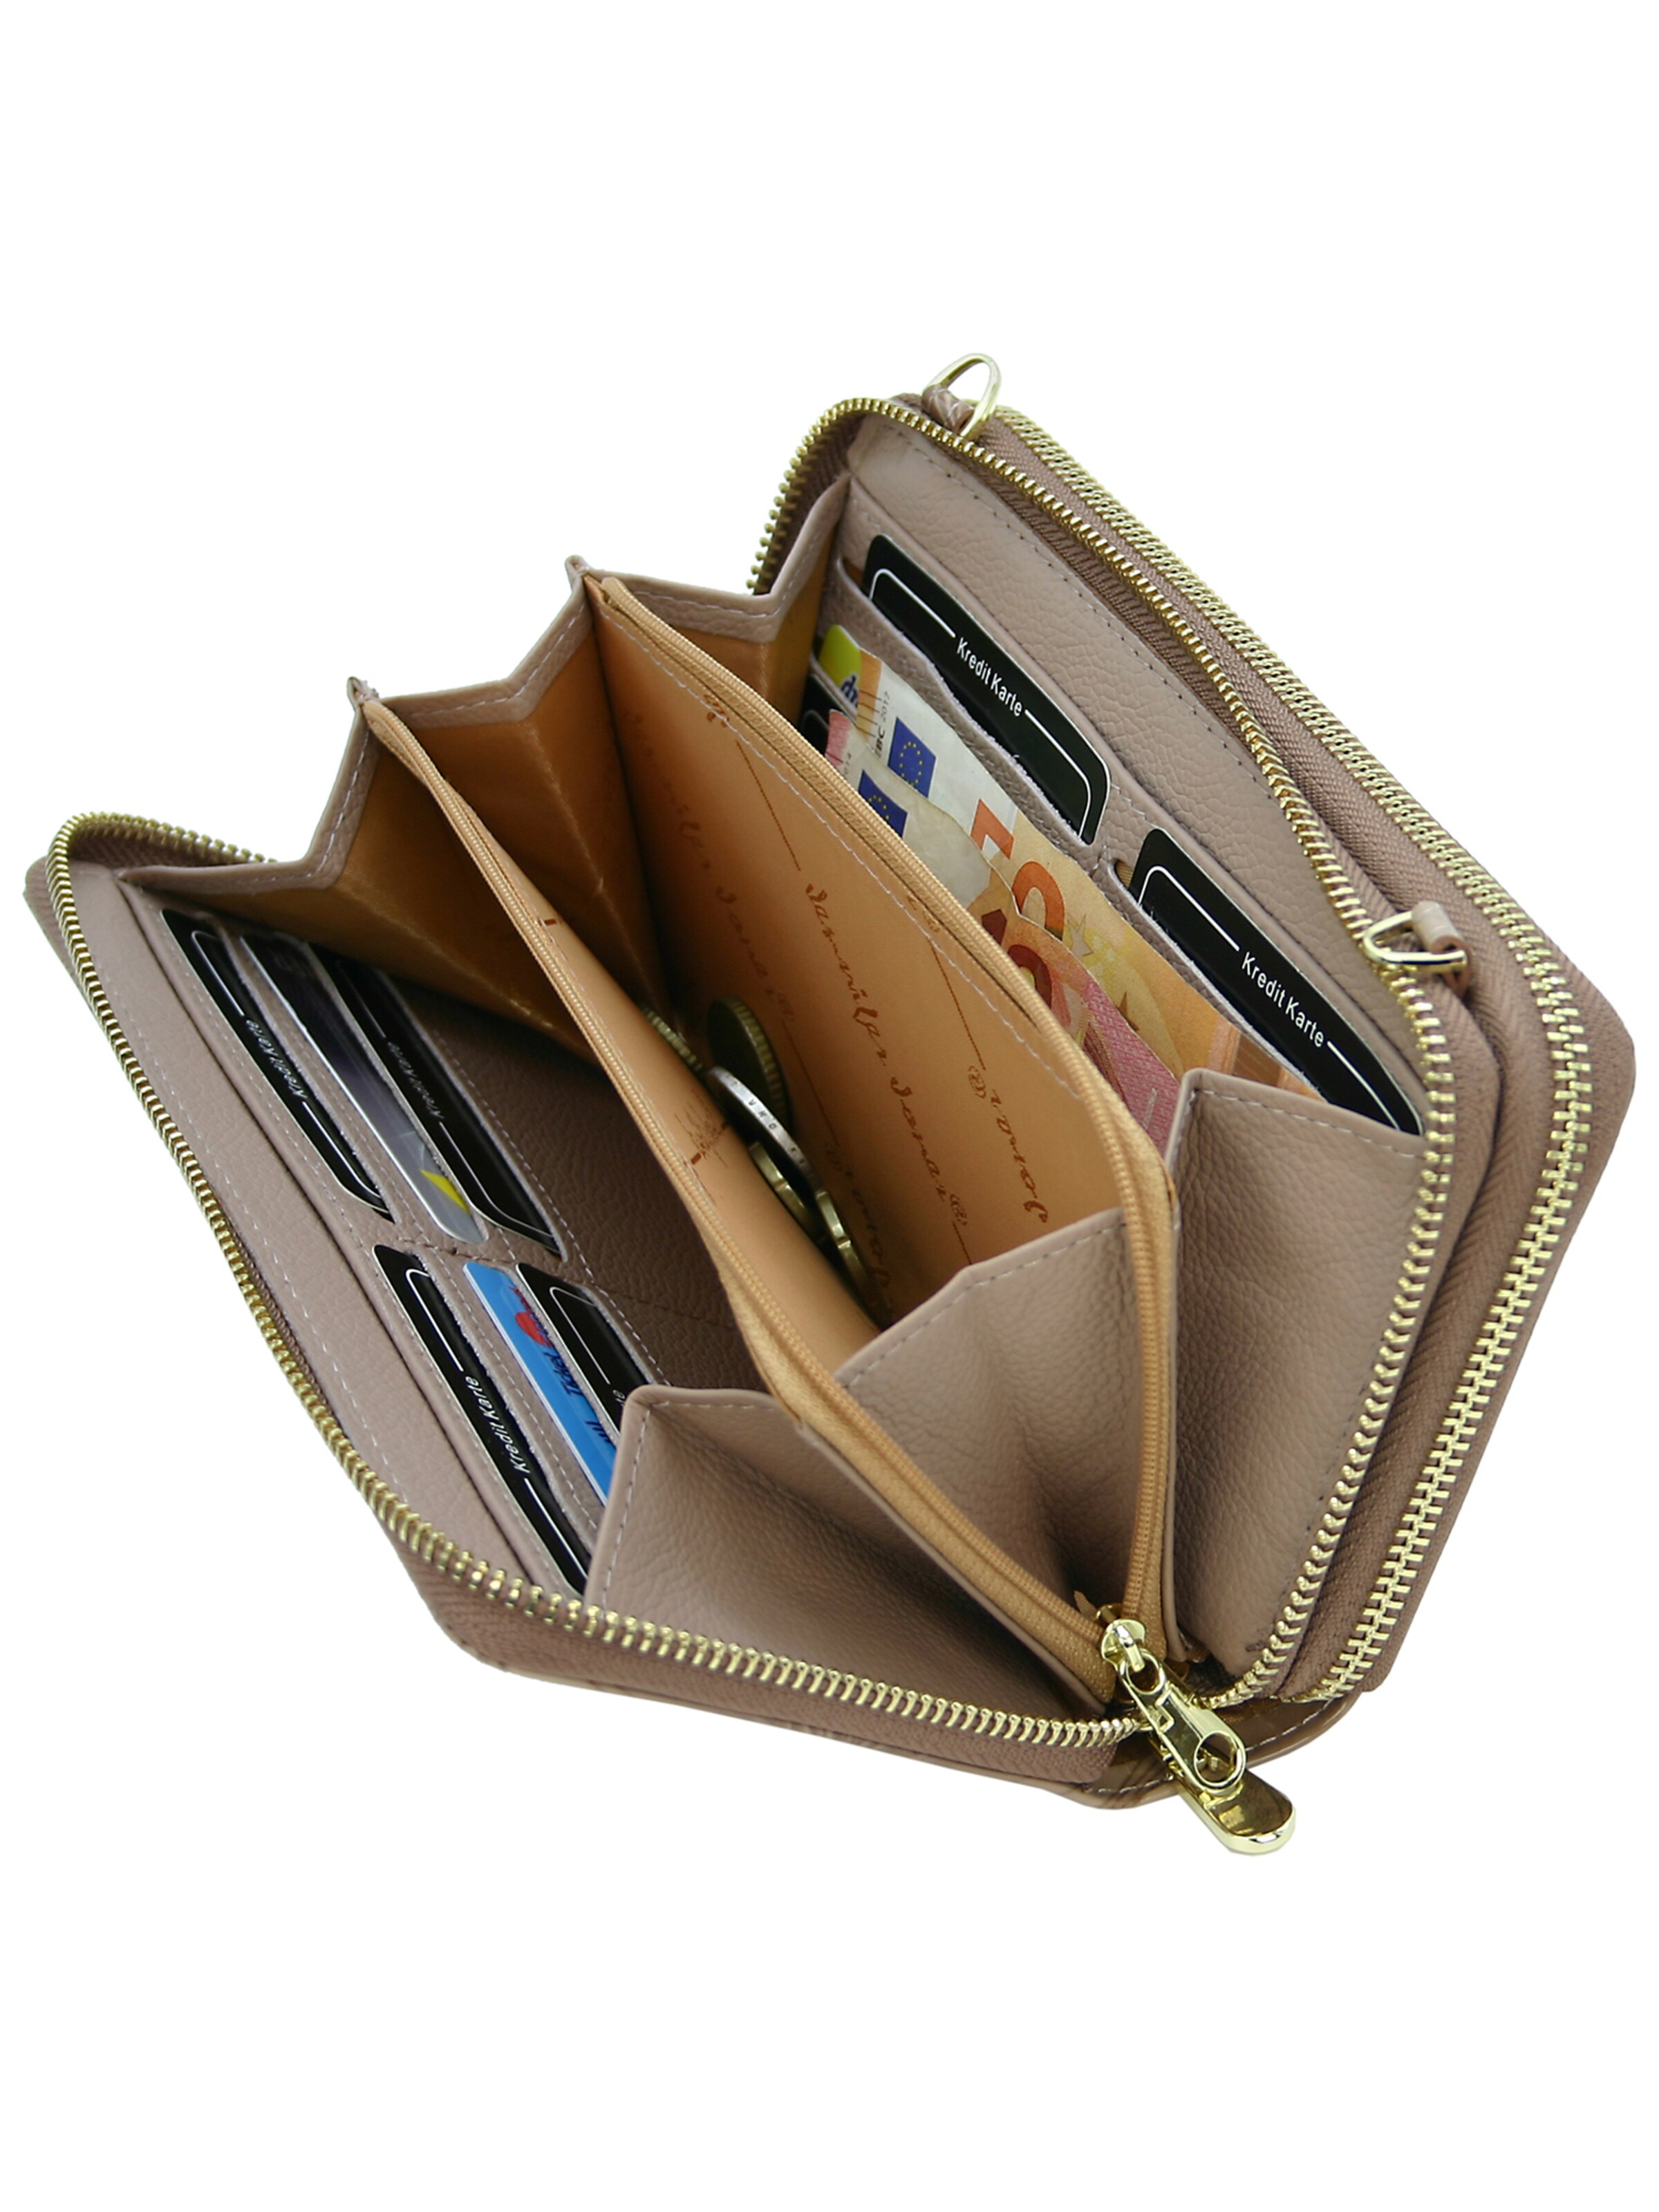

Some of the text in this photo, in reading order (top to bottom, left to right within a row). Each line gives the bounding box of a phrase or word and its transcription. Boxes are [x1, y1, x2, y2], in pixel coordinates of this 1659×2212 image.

[957, 637, 1022, 717] Kredit Karte
[1241, 952, 1324, 1048] Kredit Karte
[245, 1020, 308, 1097] Kredit Karte
[465, 1376, 530, 1474] Kredit Karte
